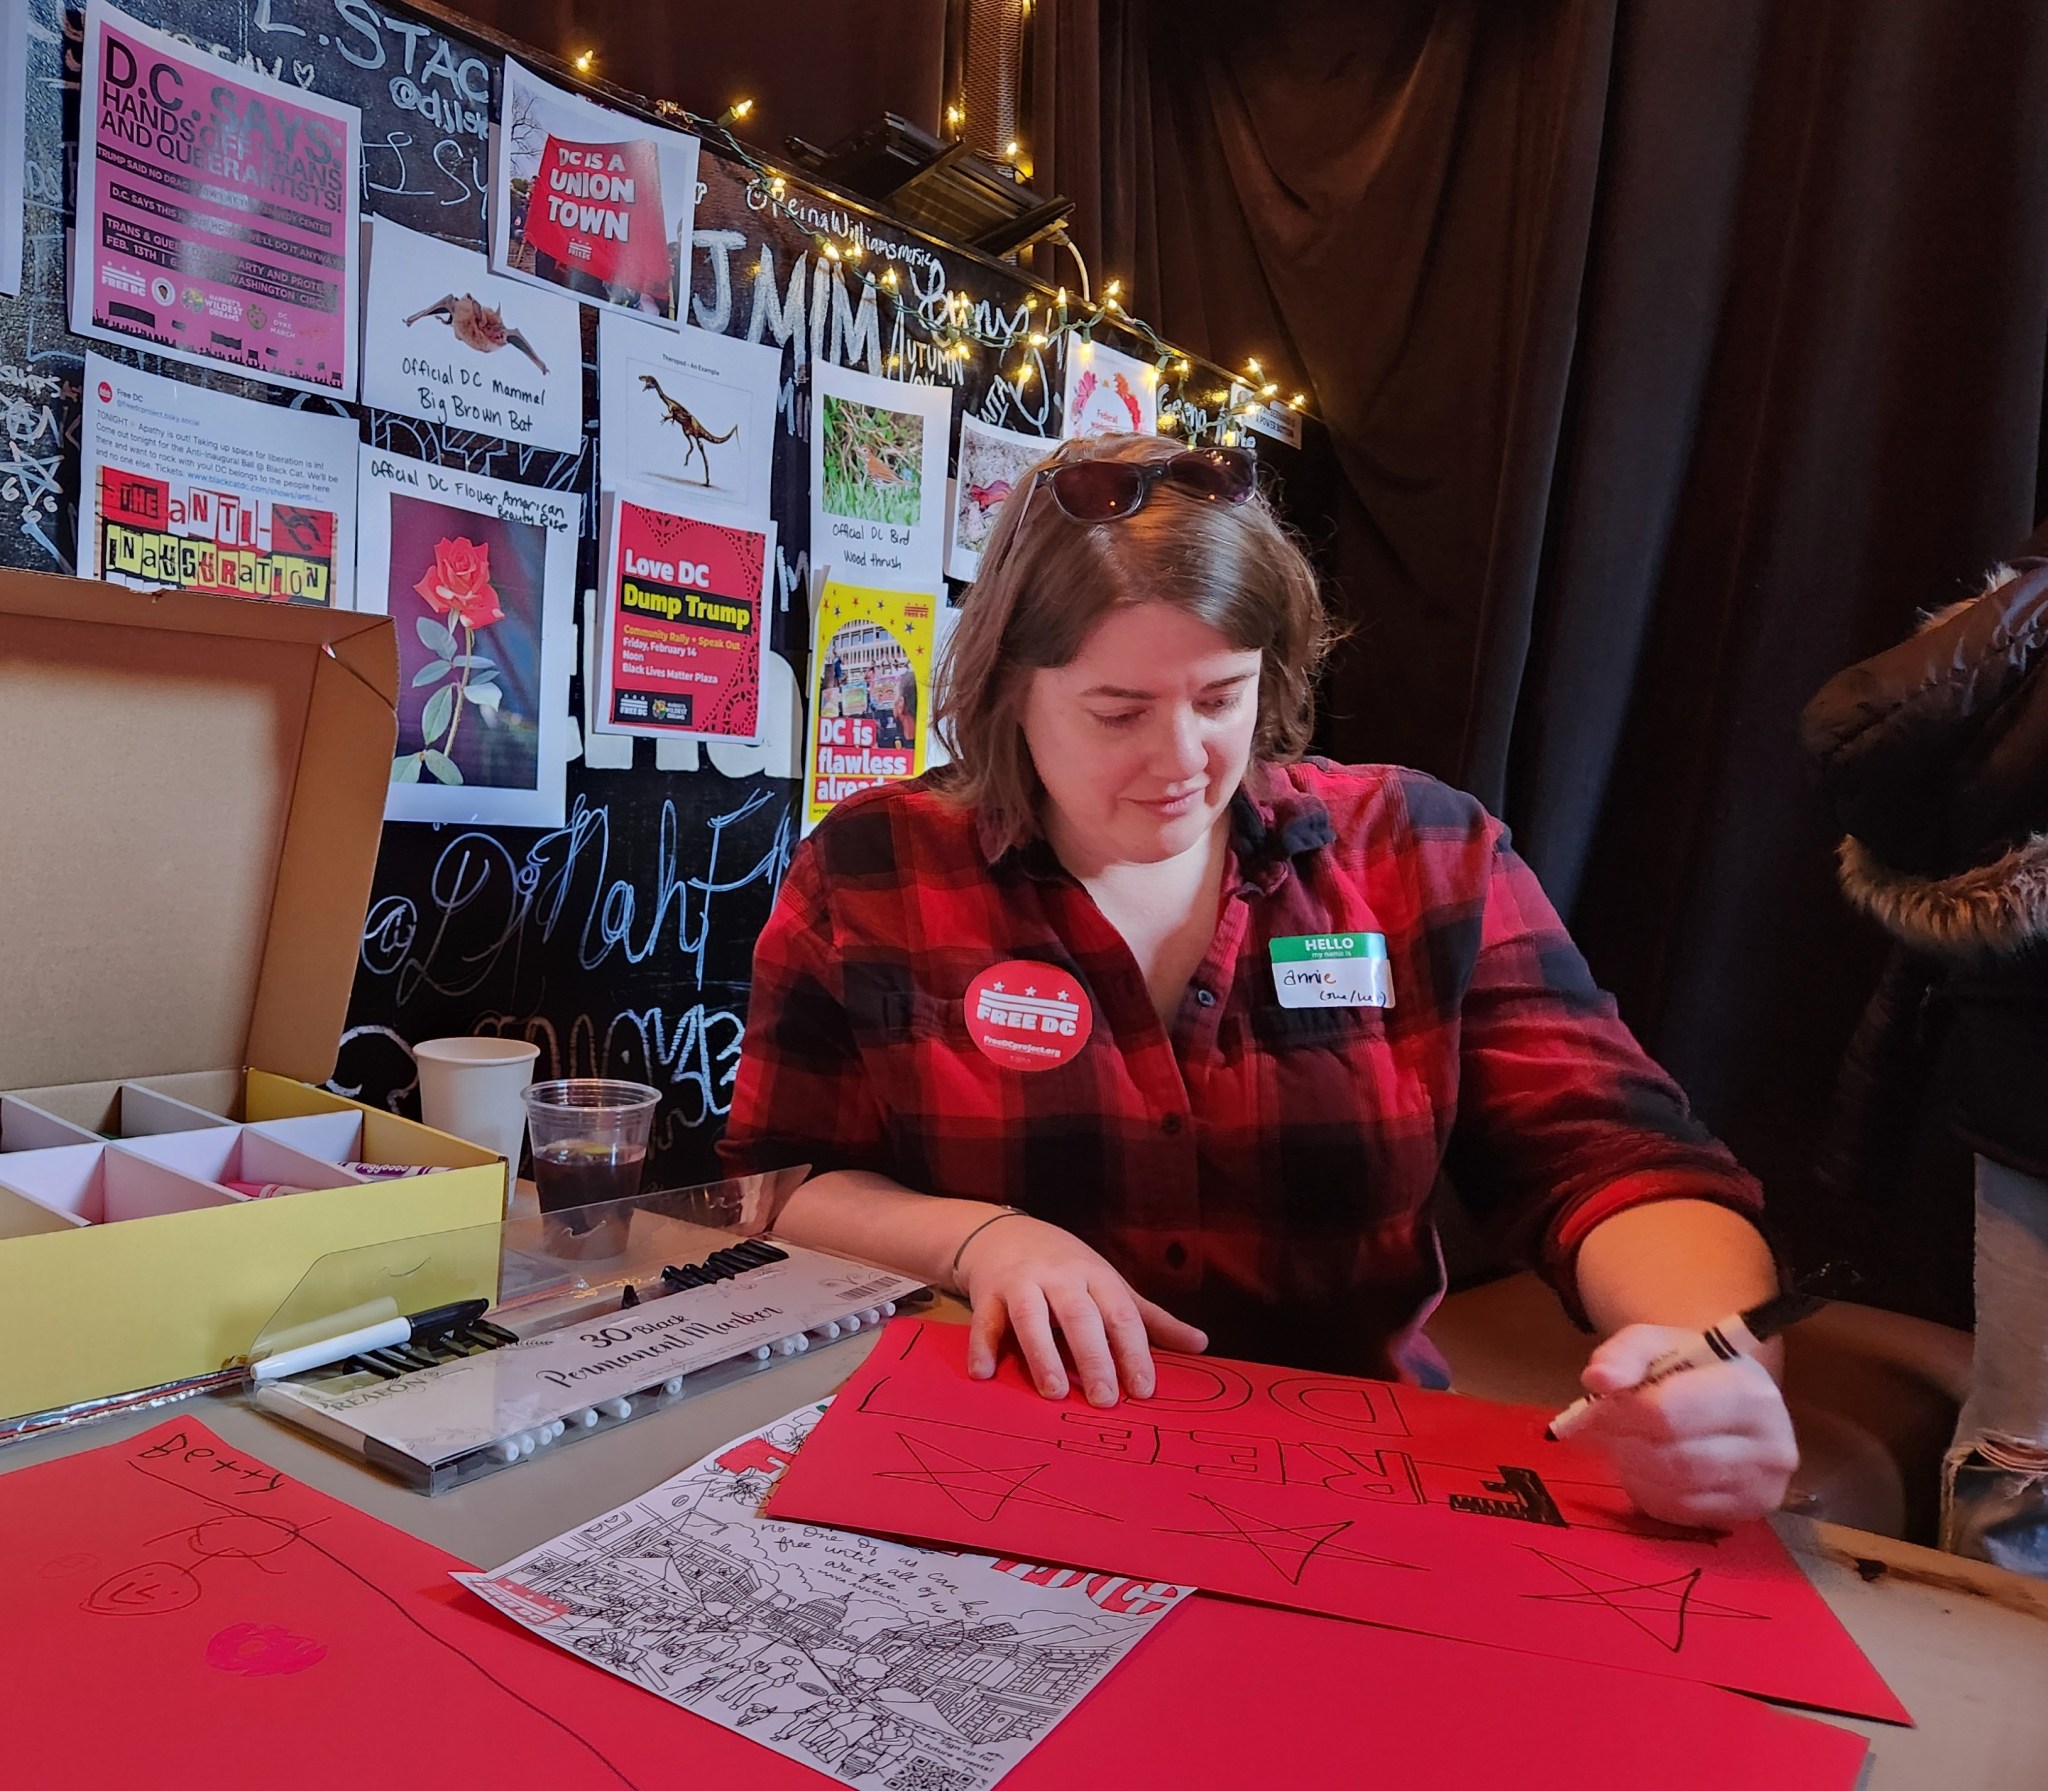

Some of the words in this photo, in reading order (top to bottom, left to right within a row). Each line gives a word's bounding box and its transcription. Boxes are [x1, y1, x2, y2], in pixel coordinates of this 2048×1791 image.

[106, 35, 201, 121] D.C.
[103, 81, 195, 143] HANDS
[200, 124, 252, 161] OFF
[259, 142, 342, 191] TRANS
[101, 111, 152, 148] AND
[156, 134, 240, 181] QUEER
[242, 163, 342, 214] ARTISTS!
[558, 147, 583, 167] DC
[585, 153, 603, 170] IS
[607, 153, 626, 172] A
[97, 146, 126, 165] TRUMP
[127, 160, 148, 174] SAID
[149, 168, 163, 180] NO
[164, 173, 189, 190] DRAG
[299, 217, 331, 233] CENTER
[550, 168, 636, 203] UNION
[112, 186, 130, 201] D.C.
[131, 194, 155, 210] SAYS
[156, 203, 177, 218] THIS
[275, 241, 289, 251] DO
[290, 245, 298, 254] IT
[547, 195, 630, 243] TOWN
[106, 217, 141, 238] TRANS
[143, 231, 151, 242] &
[267, 269, 289, 282] AND
[106, 234, 130, 251] FEB.
[133, 244, 157, 261] 13TH
[228, 273, 296, 300] WASHINGTON
[102, 275, 130, 292] FREE
[131, 284, 147, 297] DC
[205, 298, 244, 316] WILDEST
[208, 307, 240, 323] DREAMS
[269, 326, 297, 340] MARCH
[662, 353, 687, 368] Theropod
[690, 362, 697, 370] An
[698, 364, 720, 377] Example
[116, 388, 132, 400] Free
[132, 393, 144, 403] DC
[402, 357, 454, 386] Official
[460, 369, 483, 388] DC
[492, 379, 546, 407] Mammal
[417, 387, 449, 425] Big
[451, 394, 502, 427] Brown
[508, 410, 534, 433] Bat
[96, 422, 116, 435] Come
[117, 429, 130, 439] out
[130, 432, 157, 447] tonight
[158, 439, 169, 449] for
[171, 443, 185, 454] the
[186, 447, 240, 466] Anti-Inaugural
[241, 458, 255, 468] Ball
[256, 462, 265, 472] @
[266, 464, 287, 475] Black
[289, 468, 304, 478] Cat.
[307, 471, 327, 482] We'll
[328, 475, 339, 483] be
[97, 409, 129, 427] TONIGHT
[138, 423, 166, 438] Apathy
[167, 429, 174, 439] is
[175, 431, 191, 443] out!
[194, 436, 219, 450] Taking
[220, 444, 231, 453] up
[231, 446, 254, 457] space
[255, 450, 266, 459] for
[267, 452, 304, 467] liberation
[305, 460, 313, 468] is
[314, 461, 325, 470] in!
[95, 448, 109, 459] and
[109, 451, 119, 461] no
[119, 455, 134, 466] one
[134, 459, 152, 471] else.
[154, 462, 186, 479] Tickets:
[96, 435, 113, 447] there
[114, 441, 128, 451] and
[129, 445, 148, 456] want
[149, 449, 157, 459] to
[158, 451, 176, 463] rock
[178, 457, 195, 468] with
[196, 460, 214, 472] you!
[215, 464, 228, 475] DC
[229, 468, 258, 482] belongs
[259, 475, 268, 483] to
[269, 476, 281, 486] the
[283, 480, 311, 491] people
[312, 484, 331, 493] here
[371, 460, 419, 487] Official
[428, 474, 449, 492] DC
[455, 483, 500, 506] Flower
[119, 482, 159, 519] THE
[871, 526, 883, 541] DC
[890, 529, 910, 545] Bird
[625, 548, 675, 581] Love
[678, 560, 710, 588] DC
[843, 550, 867, 567] Wood
[870, 552, 902, 570] thrush
[623, 583, 682, 620] Dump
[685, 594, 750, 631] Trump
[623, 624, 669, 642] Community
[669, 631, 690, 646] Rally
[698, 636, 724, 648] Speak
[725, 640, 741, 650] Out
[623, 637, 650, 651] Friday,
[650, 642, 686, 658] February
[687, 646, 697, 657] 14
[622, 650, 645, 662] Noon
[622, 662, 645, 675] Black
[645, 665, 666, 678] Lives
[666, 669, 694, 682] Matter
[695, 673, 719, 684] Plaza
[619, 706, 638, 716] FREE
[638, 708, 648, 717] DC
[819, 718, 846, 746] DC
[852, 718, 873, 747] is
[818, 746, 907, 775] flawless
[816, 775, 888, 801] alre
[1305, 937, 1355, 952] HELLO
[1311, 952, 1323, 960] my
[1324, 950, 1344, 958] name
[1283, 969, 1337, 986] annie
[976, 1004, 1038, 1031] FREE
[1040, 1016, 1077, 1037] DC
[983, 1035, 1062, 1058] FreeDCproject.org
[579, 1328, 633, 1349] 30
[632, 1314, 690, 1336] Black
[536, 1332, 695, 1389] Permanent
[681, 1306, 784, 1341] Marker
[761, 1522, 791, 1533] no
[898, 1556, 918, 1568] us
[773, 1535, 813, 1553] free
[824, 1544, 876, 1568] until
[887, 1568, 919, 1584] all
[918, 1585, 938, 1599] of
[930, 1600, 948, 1614] us
[824, 1560, 857, 1575] are
[858, 1572, 900, 1592] free.
[923, 1742, 954, 1758] future
[939, 1739, 961, 1752] Sign
[963, 1748, 976, 1758] up
[979, 1753, 995, 1763] for
